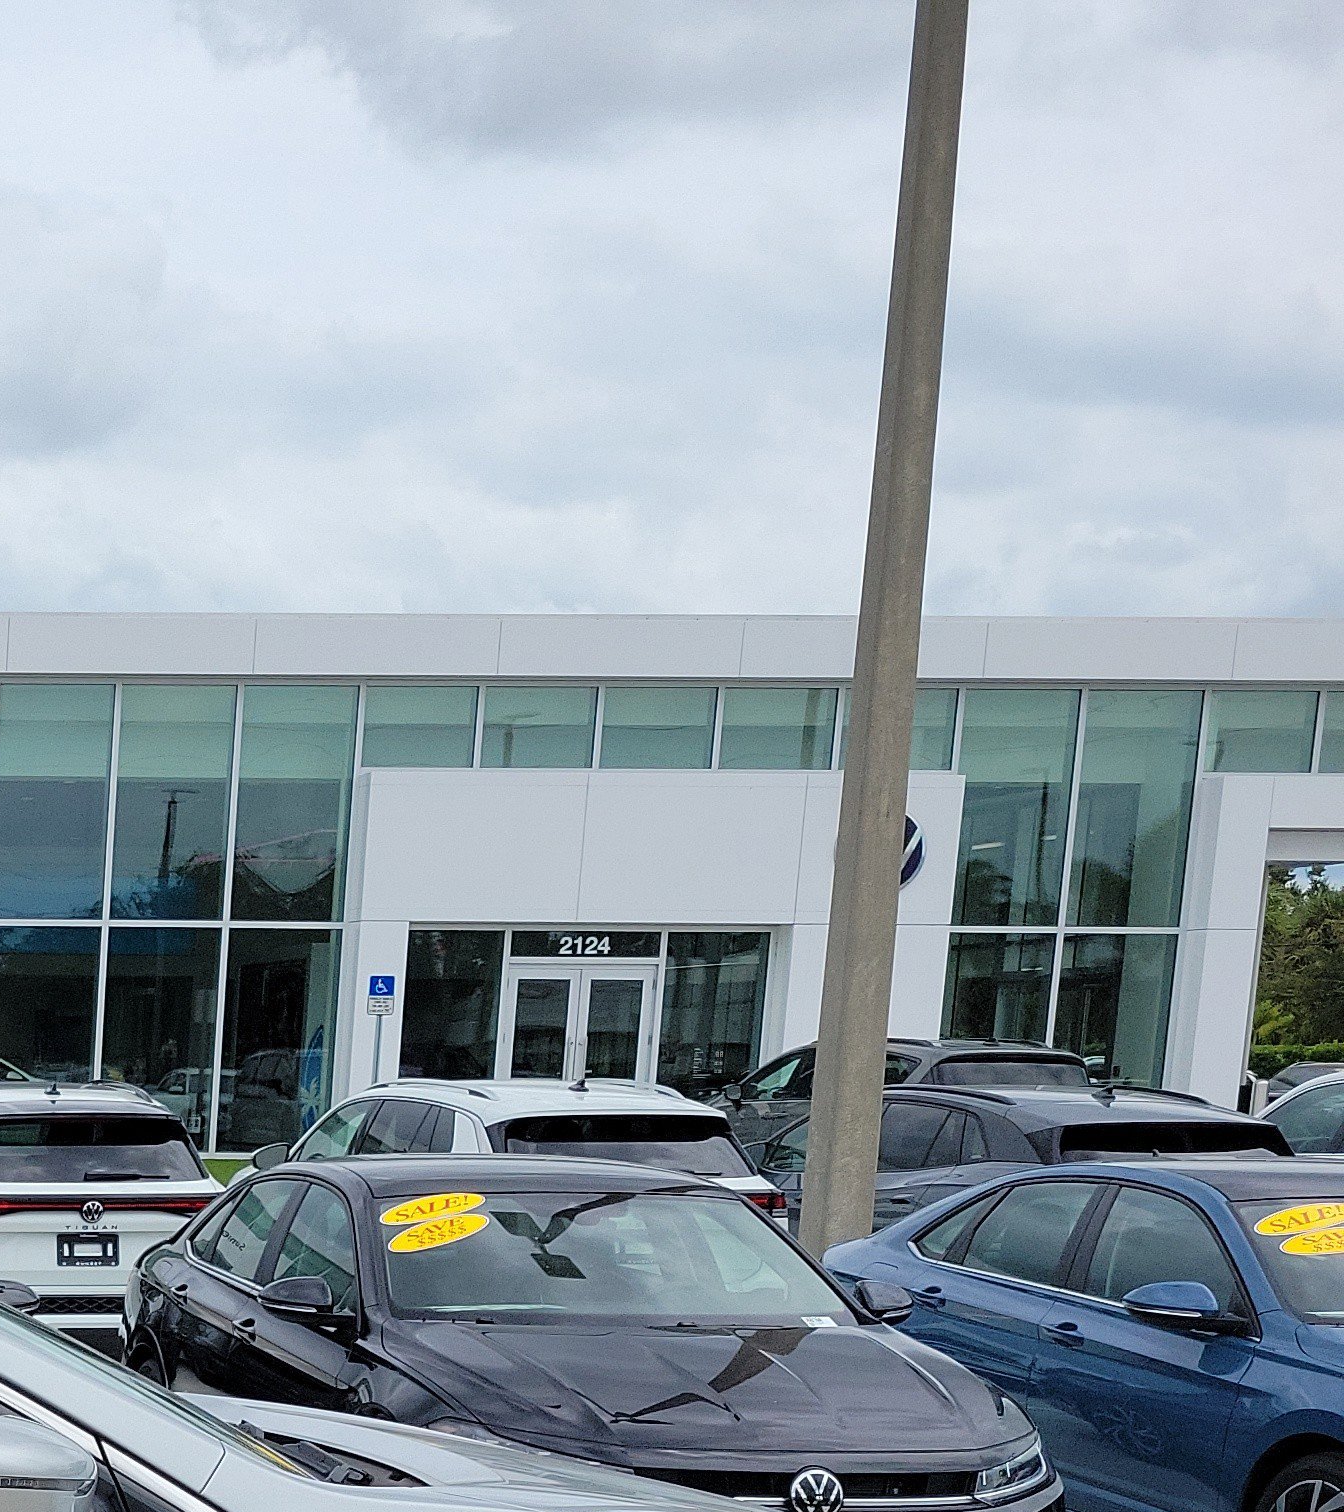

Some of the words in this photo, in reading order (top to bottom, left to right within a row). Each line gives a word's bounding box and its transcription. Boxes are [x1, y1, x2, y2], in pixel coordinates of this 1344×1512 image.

[558, 936, 611, 955] 2124
[395, 1194, 469, 1223] SALE!
[406, 1216, 465, 1243] SAVE
